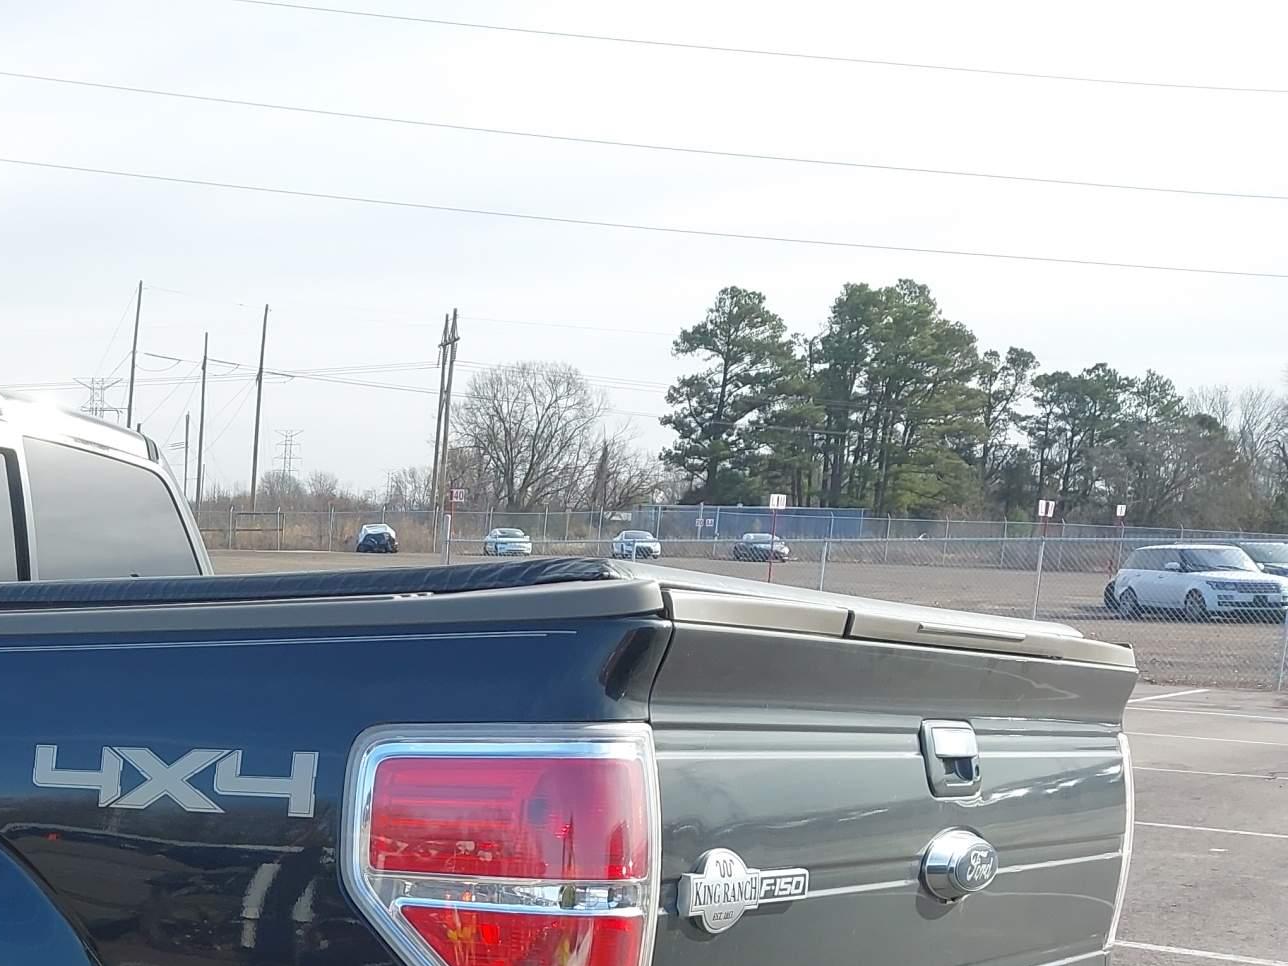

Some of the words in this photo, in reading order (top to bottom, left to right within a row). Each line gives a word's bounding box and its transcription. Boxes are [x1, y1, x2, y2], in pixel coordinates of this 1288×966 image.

[967, 850, 994, 881] Ford
[694, 881, 721, 907] KING
[723, 876, 758, 903] RANCH
